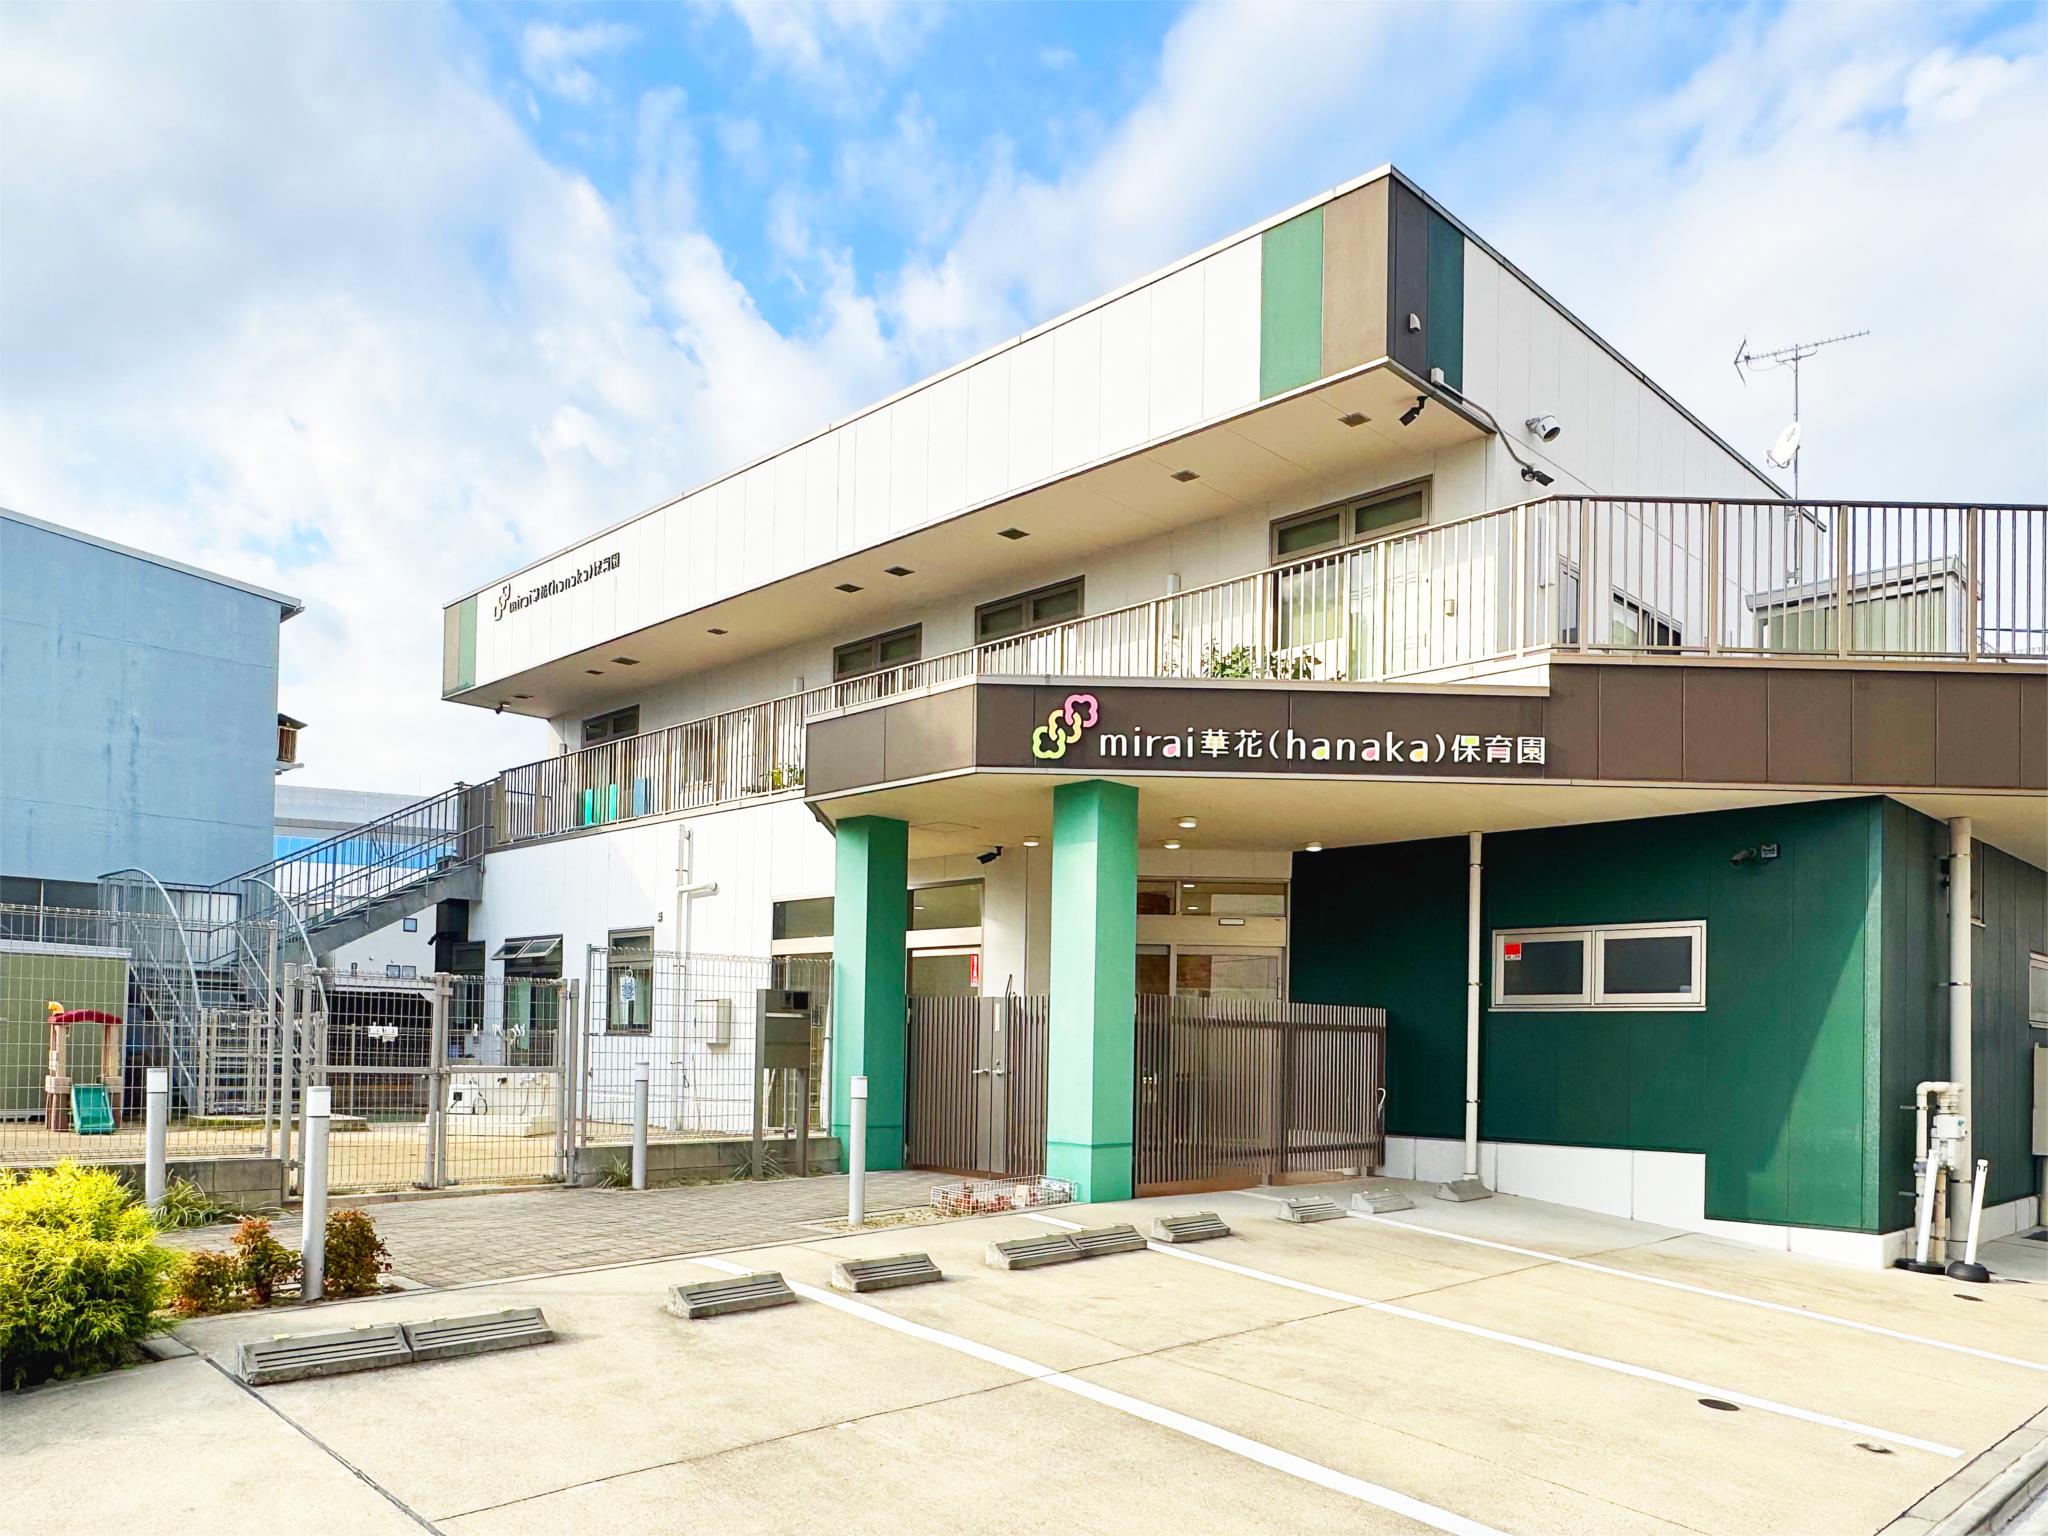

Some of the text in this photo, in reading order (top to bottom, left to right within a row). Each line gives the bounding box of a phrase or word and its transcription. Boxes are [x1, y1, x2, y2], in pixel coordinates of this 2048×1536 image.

[1100, 726, 1546, 765] mirai華花(hanaka)保育園
